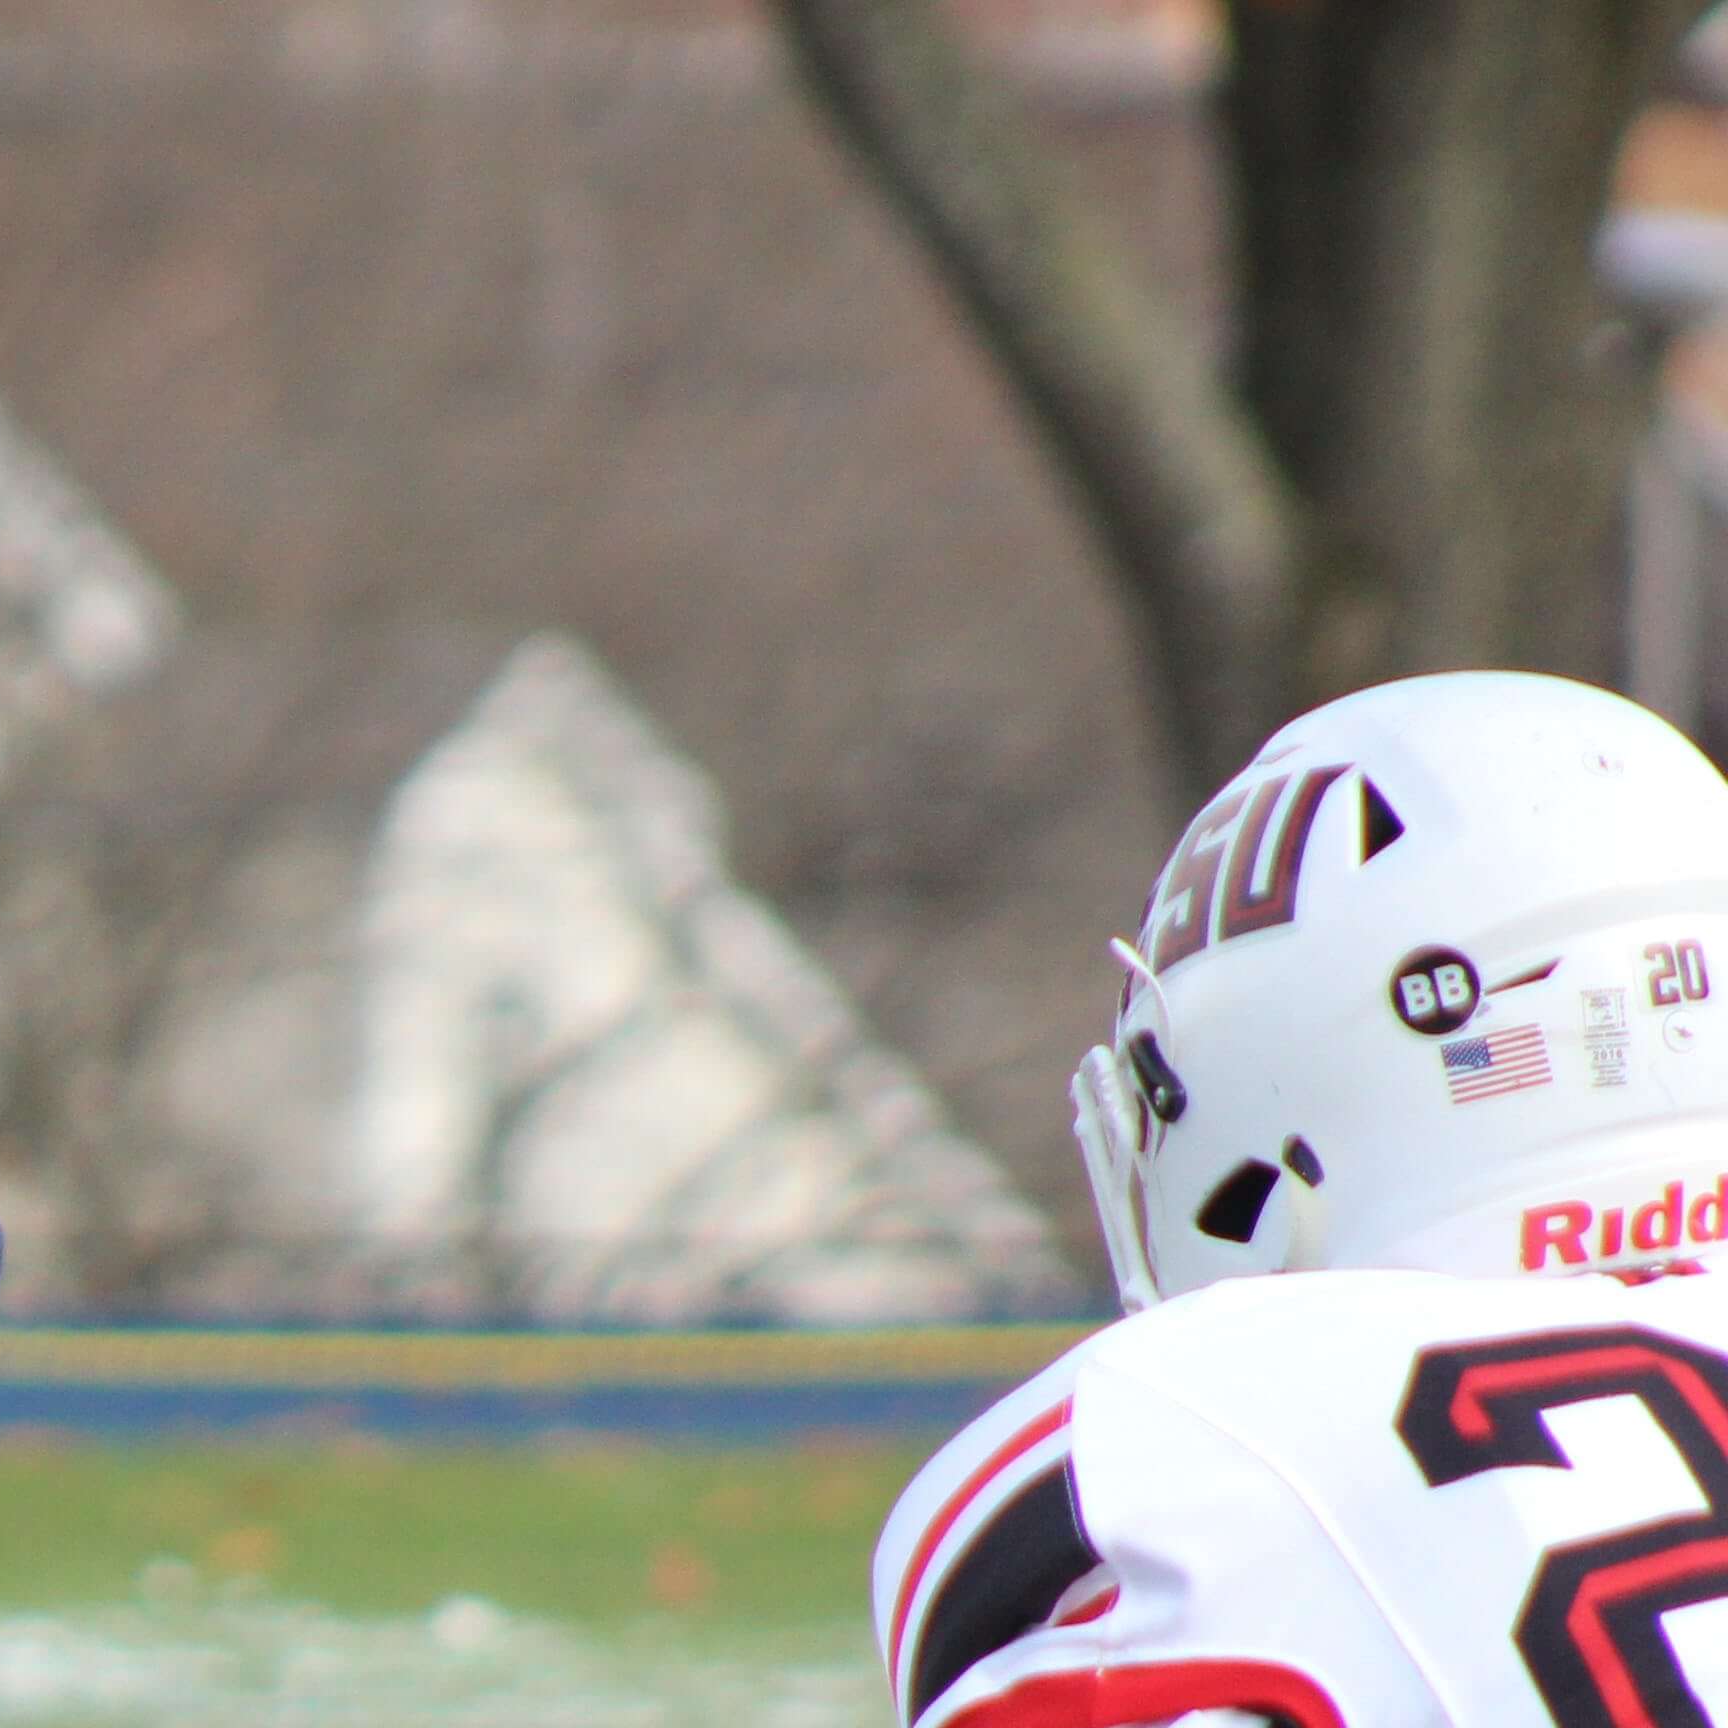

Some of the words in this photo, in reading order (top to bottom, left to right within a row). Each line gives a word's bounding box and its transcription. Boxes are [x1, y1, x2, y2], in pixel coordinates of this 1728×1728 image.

[1136, 761, 1356, 982] SU
[1398, 962, 1471, 1018] BB
[1643, 938, 1710, 1007] 20
